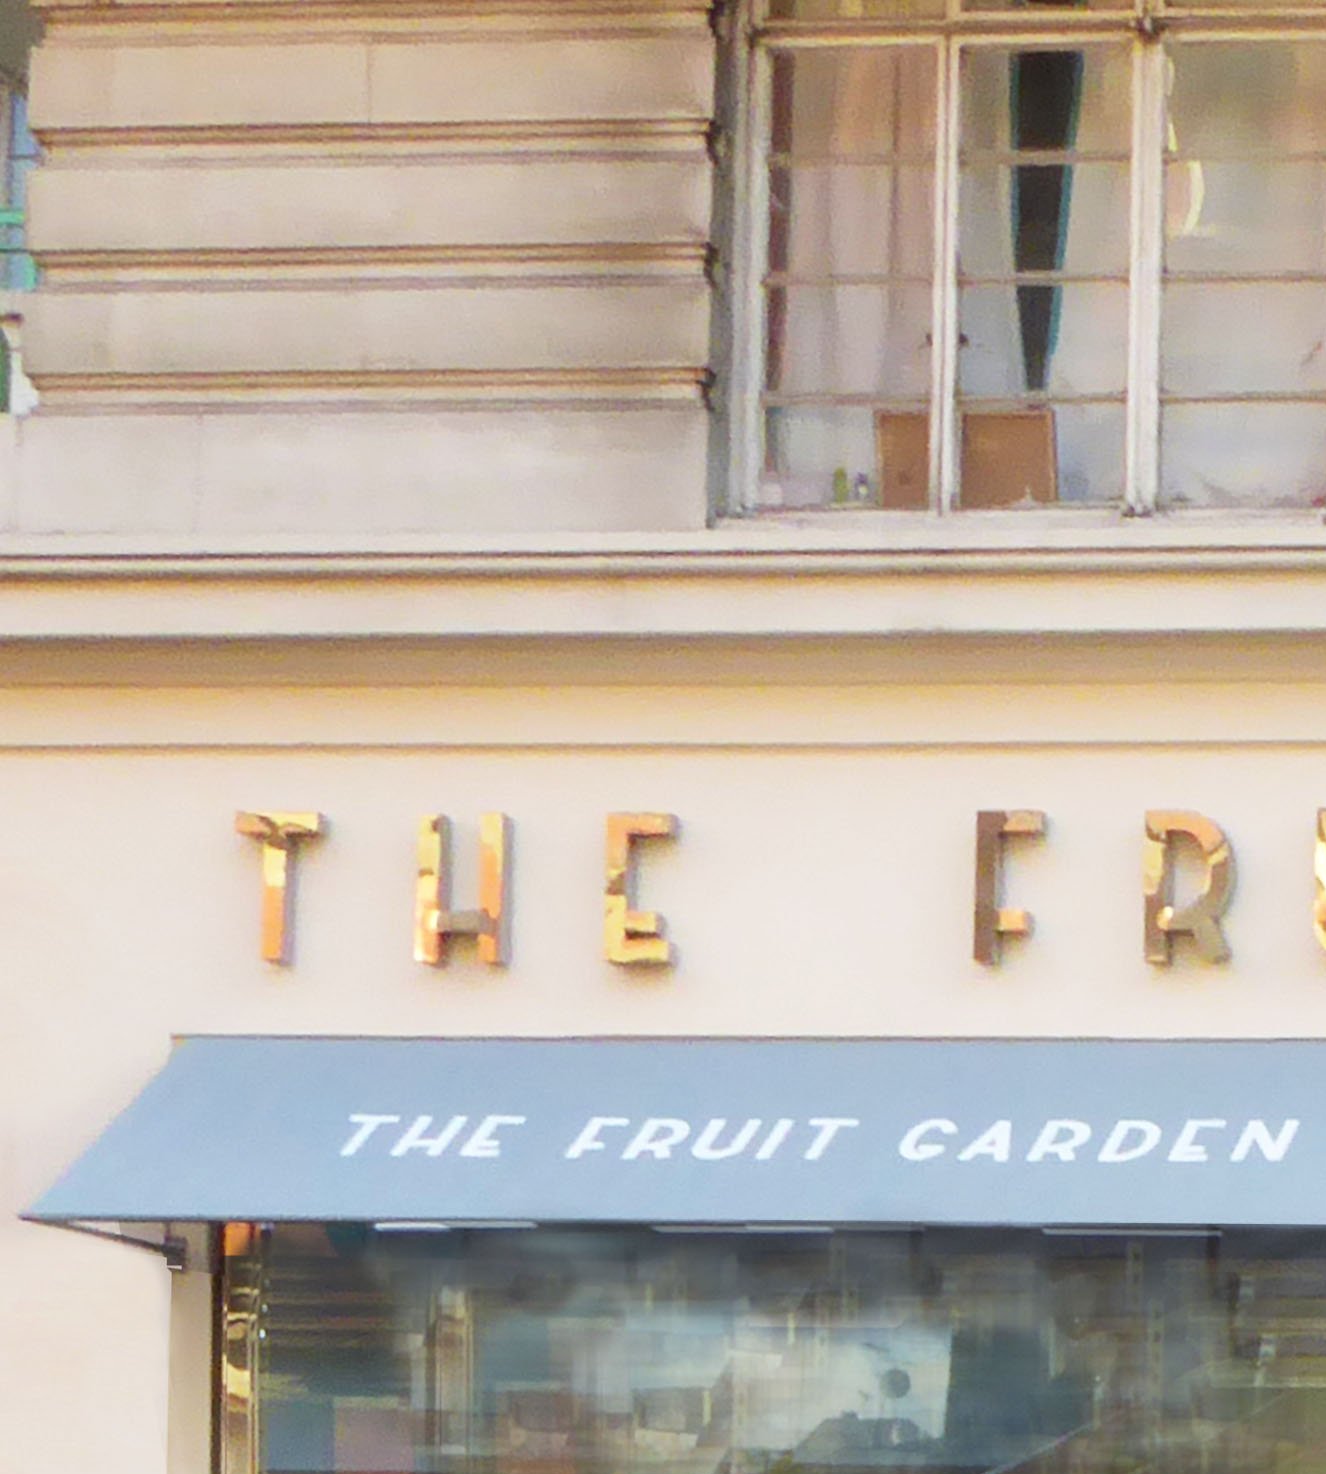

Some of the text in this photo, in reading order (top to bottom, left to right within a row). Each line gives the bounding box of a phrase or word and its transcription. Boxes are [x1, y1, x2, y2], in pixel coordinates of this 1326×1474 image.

[235, 811, 680, 966] THE
[339, 1113, 1301, 1163] THE FRUIT GARDEN
